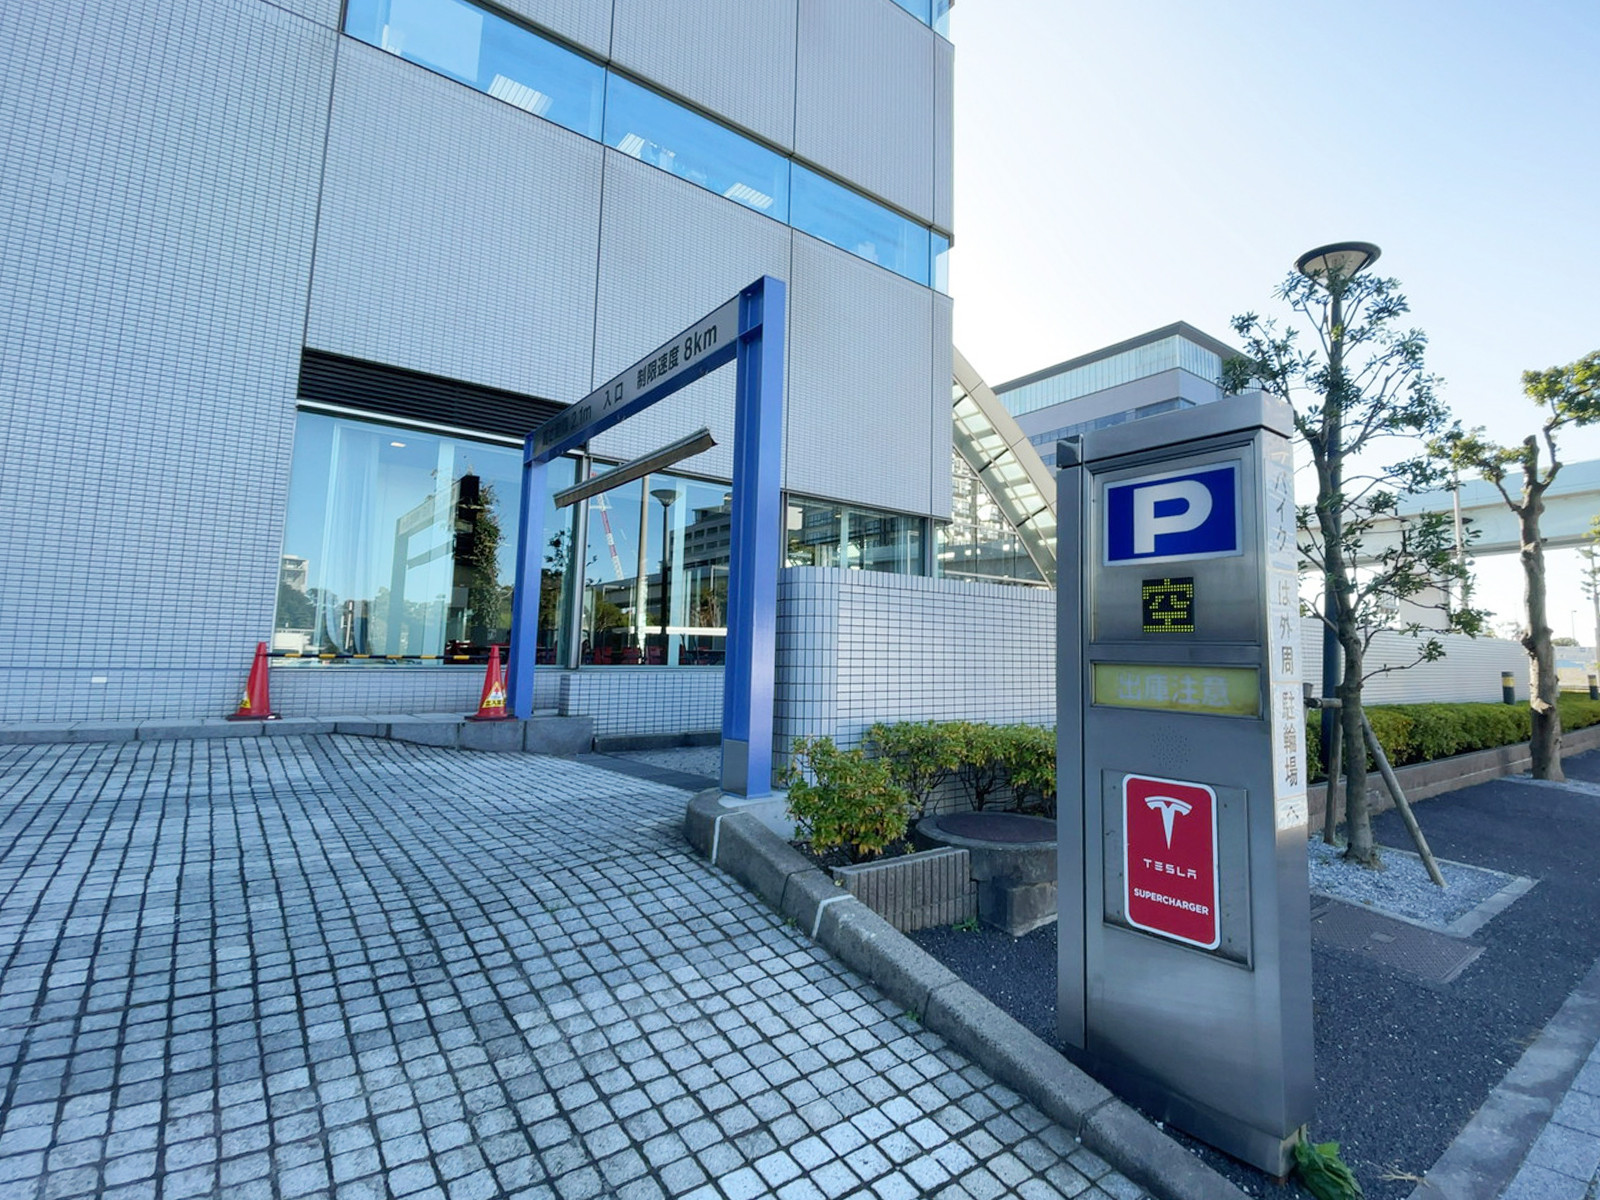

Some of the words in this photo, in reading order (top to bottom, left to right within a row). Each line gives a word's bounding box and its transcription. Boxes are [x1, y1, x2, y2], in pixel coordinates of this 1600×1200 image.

[570, 405, 592, 430] 2.1m
[603, 382, 623, 410] 入口
[636, 345, 680, 390] 制限速度
[684, 325, 718, 361] 8km
[1133, 480, 1213, 555] P
[1142, 578, 1194, 633] 空
[1118, 672, 1231, 707] 出庫注意
[1143, 858, 1198, 880] TESLA
[1133, 887, 1210, 916] SUPERCHARGER
